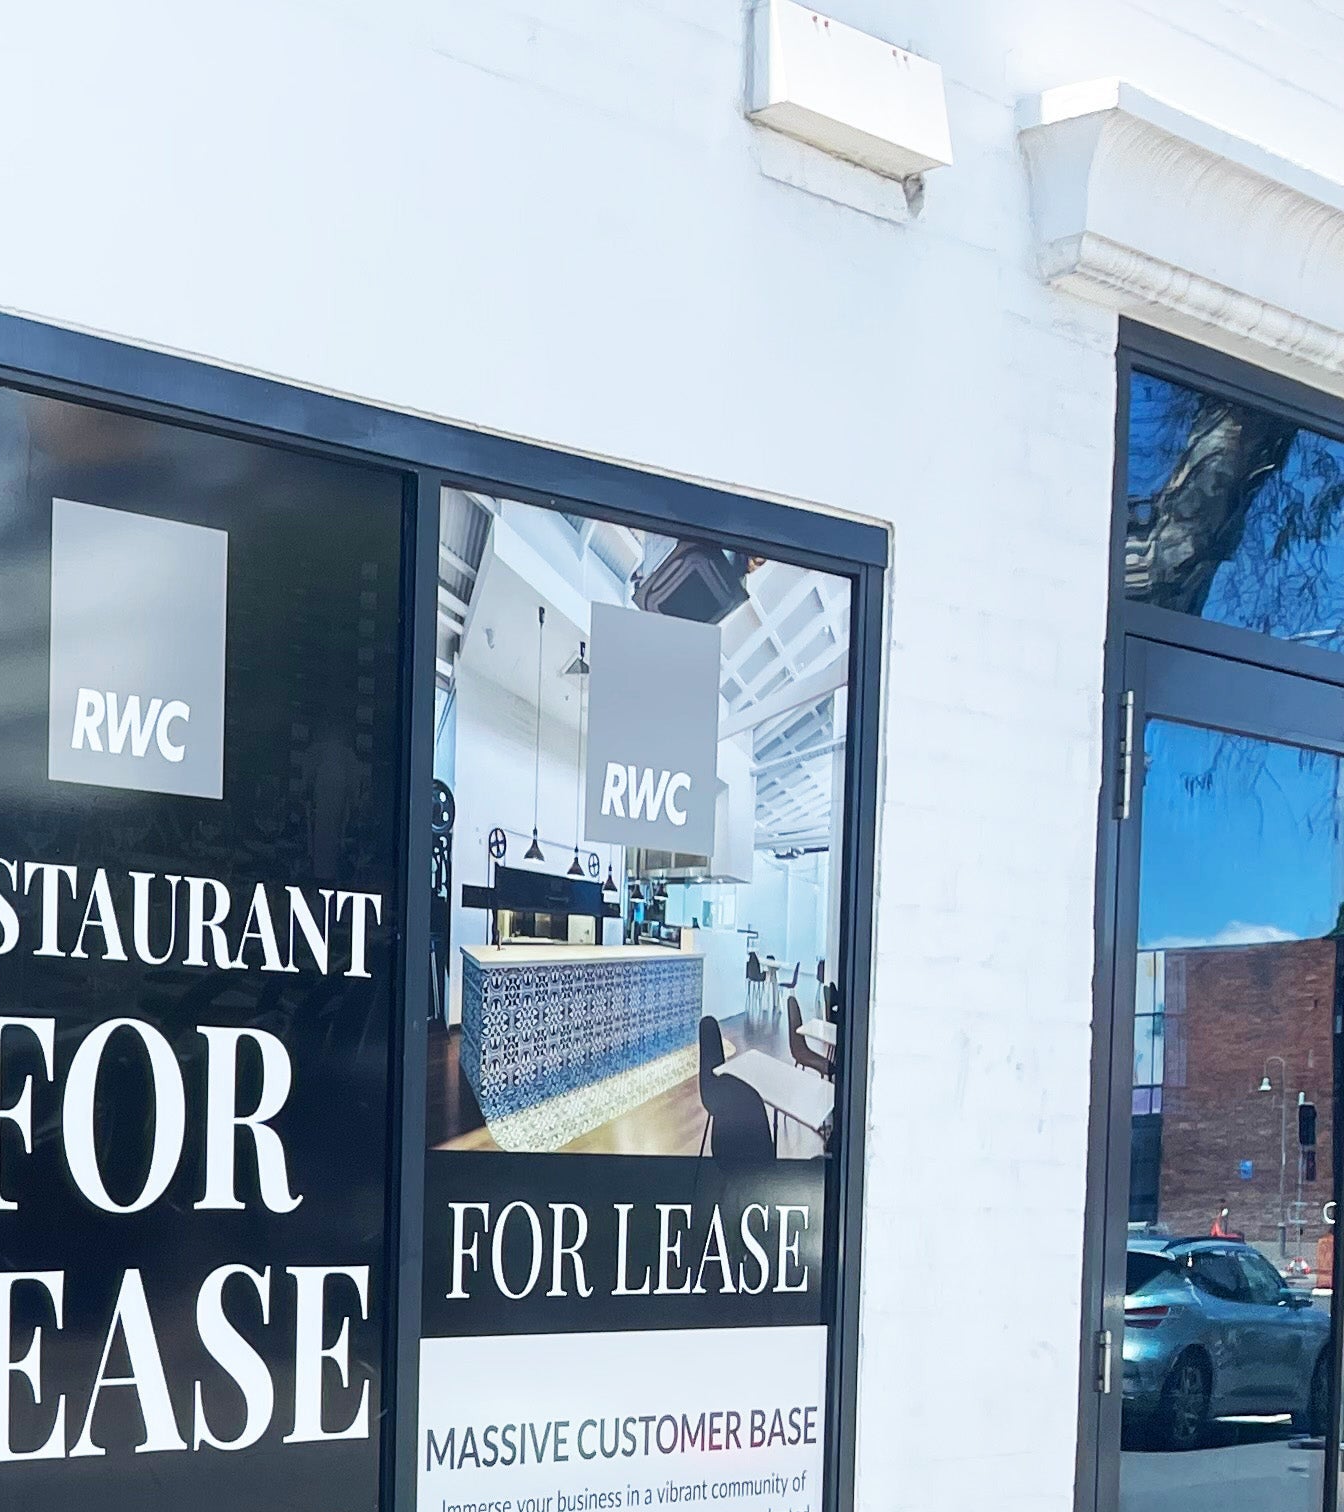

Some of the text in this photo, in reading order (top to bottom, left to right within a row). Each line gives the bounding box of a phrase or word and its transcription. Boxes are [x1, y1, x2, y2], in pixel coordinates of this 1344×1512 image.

[70, 687, 190, 763] RWC
[600, 761, 692, 826] RWC
[445, 1200, 811, 1300] FOR LEASE
[426, 1405, 818, 1472] MASSIVE CUSTOMER BASE
[557, 1487, 622, 1512] business
[626, 1484, 640, 1507] in
[644, 1488, 652, 1506] a
[656, 1479, 708, 1504] vibrant
[711, 1472, 789, 1500] community
[792, 1469, 807, 1493] of
